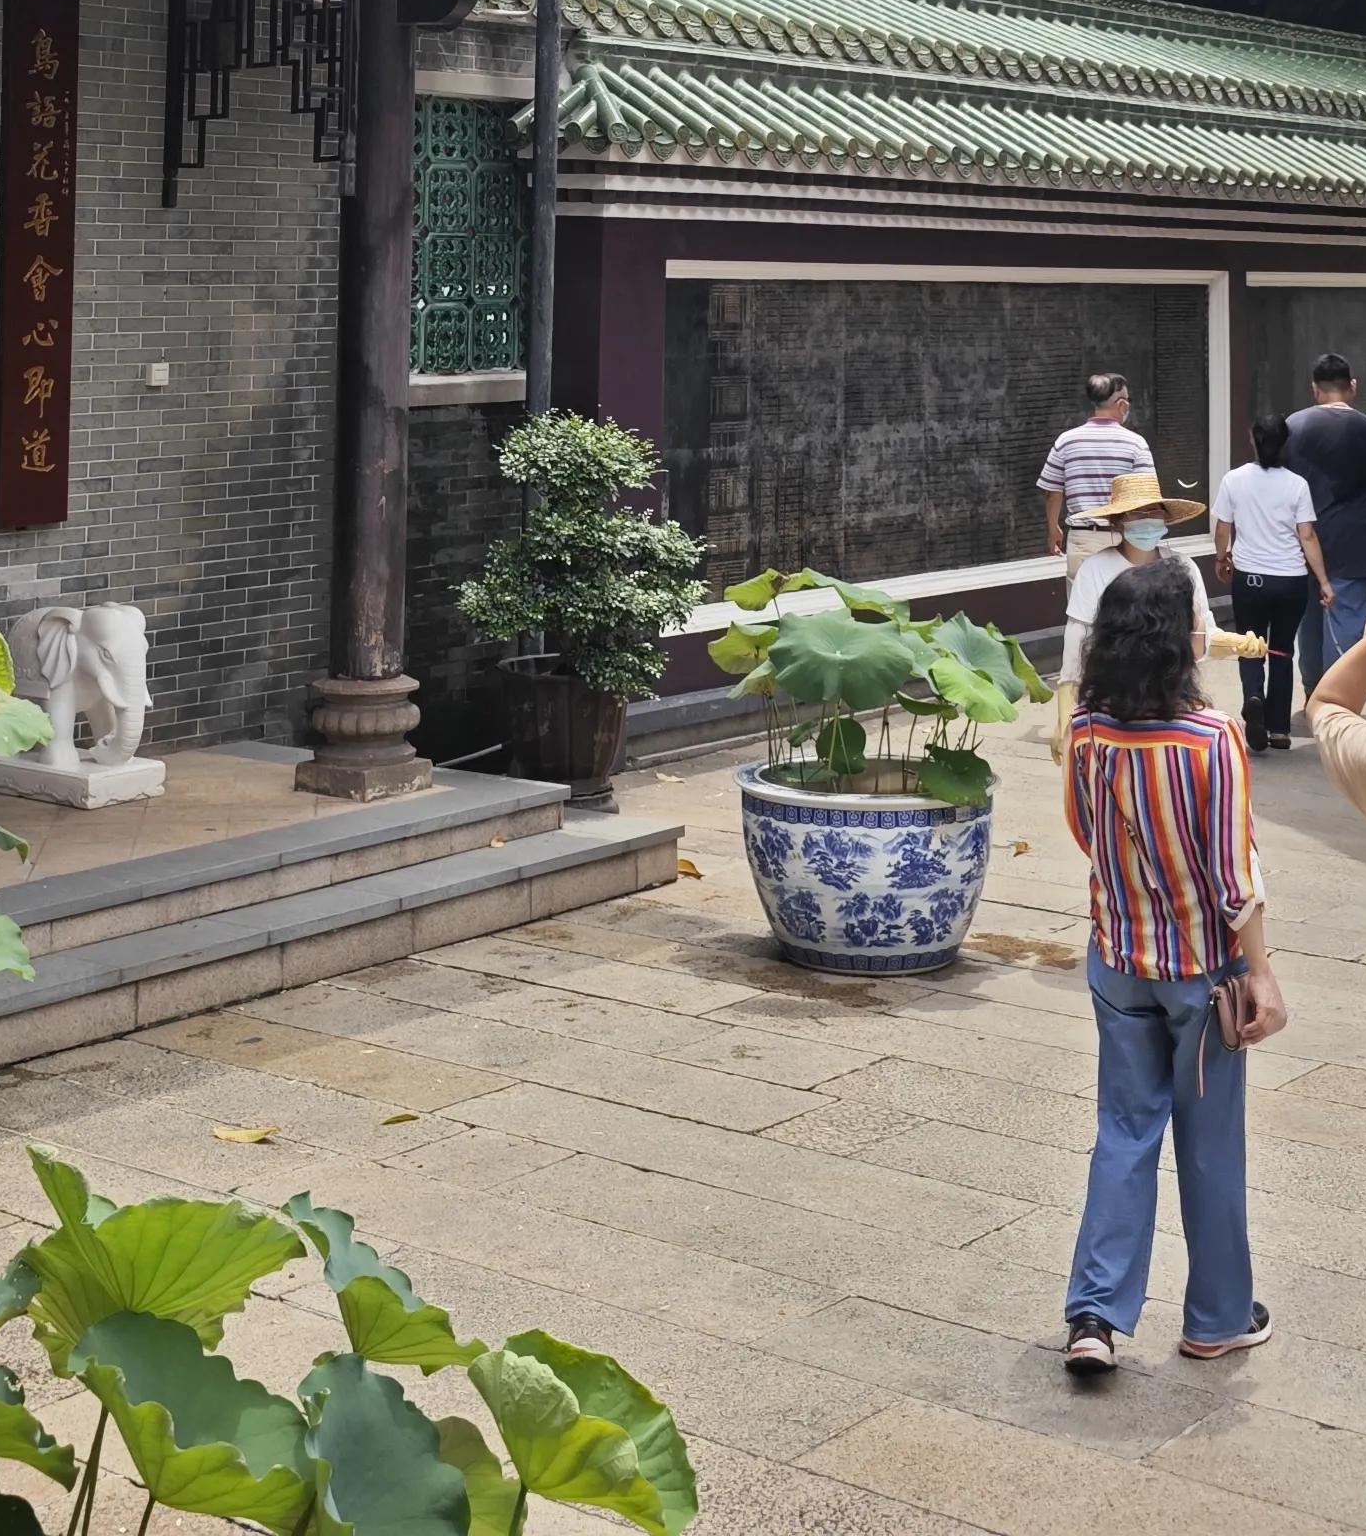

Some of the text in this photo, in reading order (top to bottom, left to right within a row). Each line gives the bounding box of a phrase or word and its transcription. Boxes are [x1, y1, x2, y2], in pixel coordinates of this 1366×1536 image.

[19, 27, 64, 474] 鳥語花香會心即道
